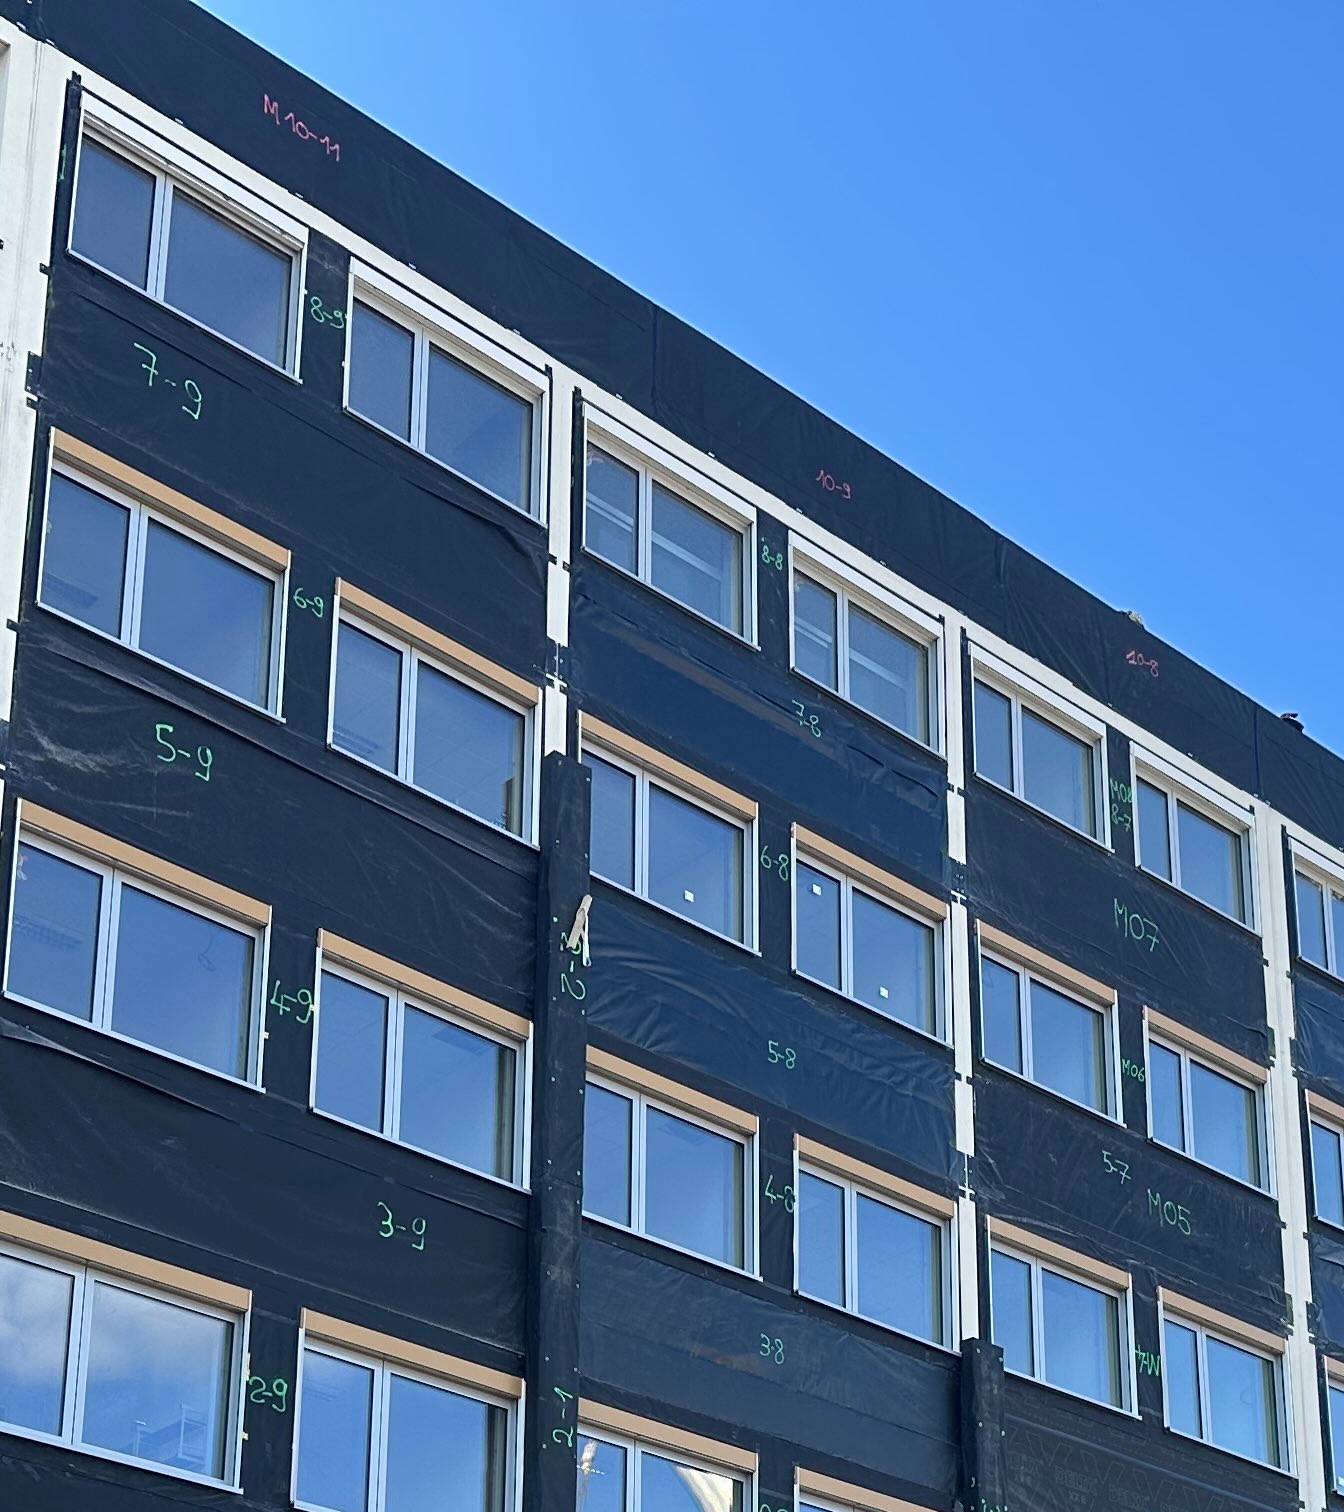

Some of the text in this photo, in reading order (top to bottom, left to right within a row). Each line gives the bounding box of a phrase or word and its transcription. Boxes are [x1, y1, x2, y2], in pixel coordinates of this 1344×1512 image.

[310, 296, 344, 329] 8-9
[133, 341, 204, 420] 7-9
[761, 544, 785, 571] 8-8
[293, 587, 325, 618] 6-9
[154, 723, 214, 780] 5-9
[760, 845, 790, 882] 6-8
[1113, 898, 1160, 952] M07
[269, 979, 314, 1024] 4-9
[767, 1040, 797, 1070] 5-8
[1122, 1059, 1145, 1082] M06
[1102, 1151, 1131, 1183] 5-7
[376, 1201, 426, 1250] 3-9
[1147, 1189, 1191, 1235] M05
[248, 1375, 288, 1413] 2-9
[552, 1386, 574, 1448] 2-1
